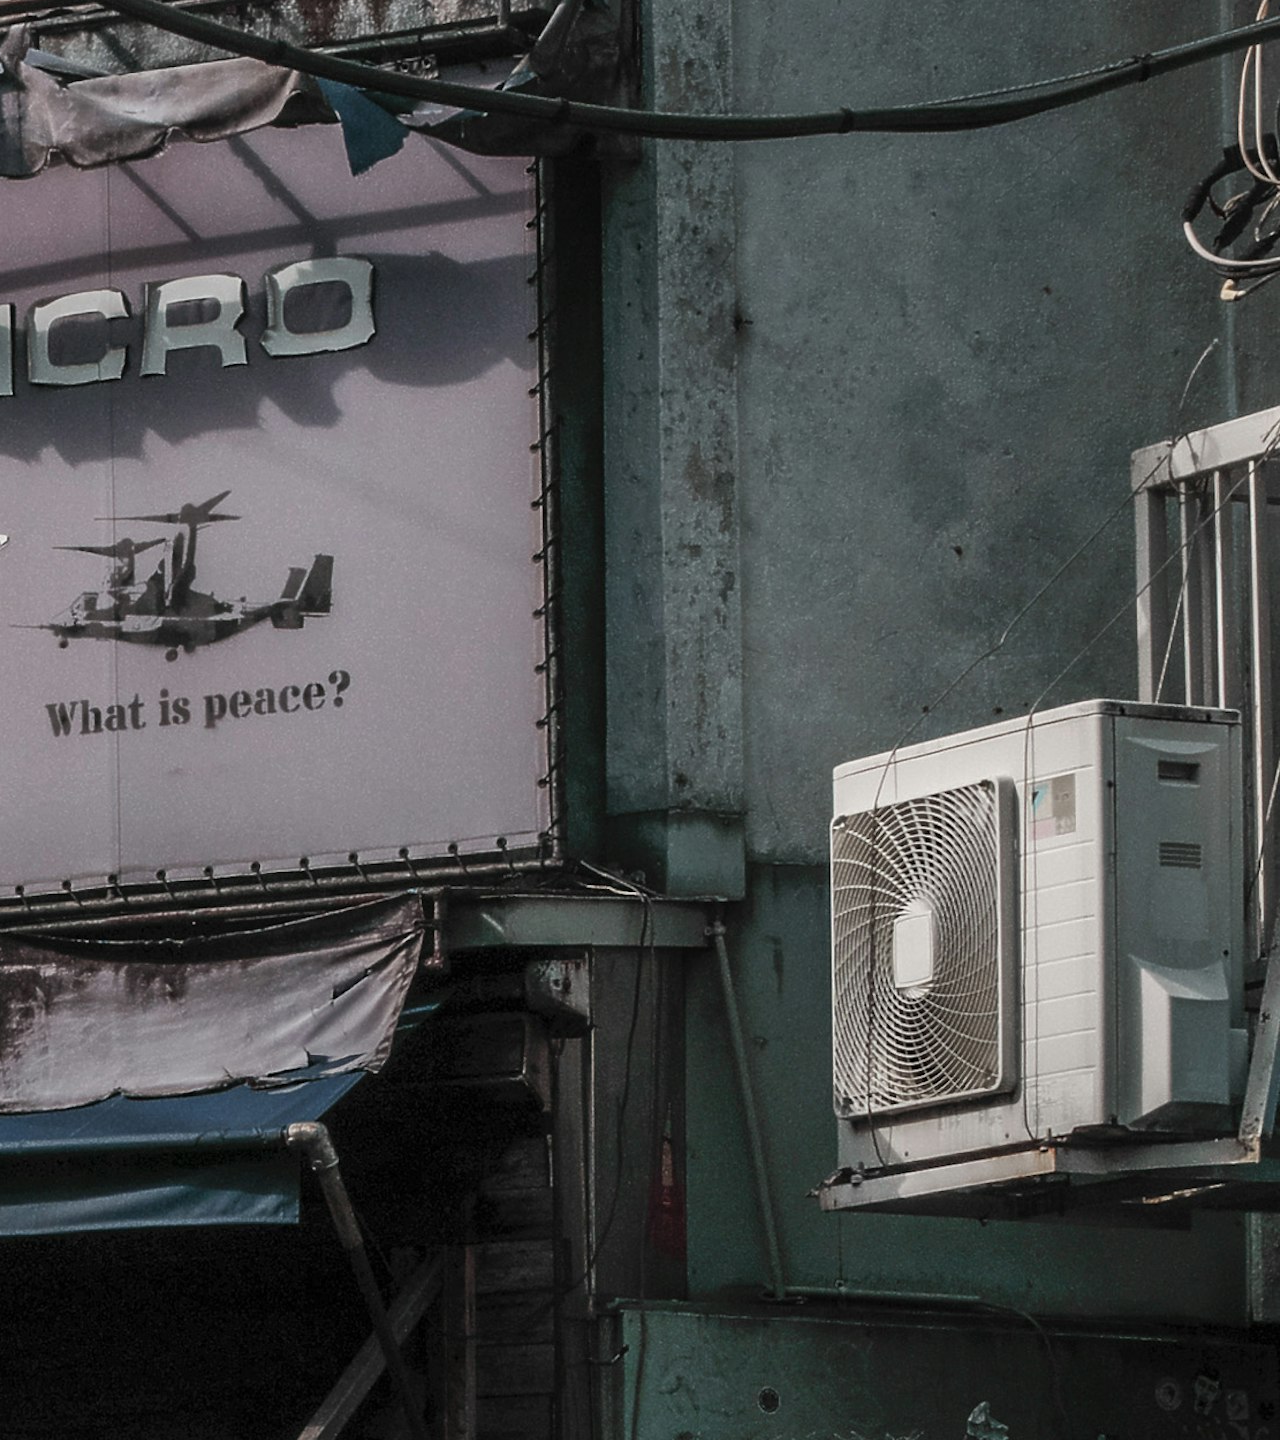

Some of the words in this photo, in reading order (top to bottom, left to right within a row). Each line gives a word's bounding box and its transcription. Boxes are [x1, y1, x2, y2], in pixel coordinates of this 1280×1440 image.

[45, 690, 147, 738] What
[159, 685, 192, 727] is
[203, 668, 353, 733] peace?
